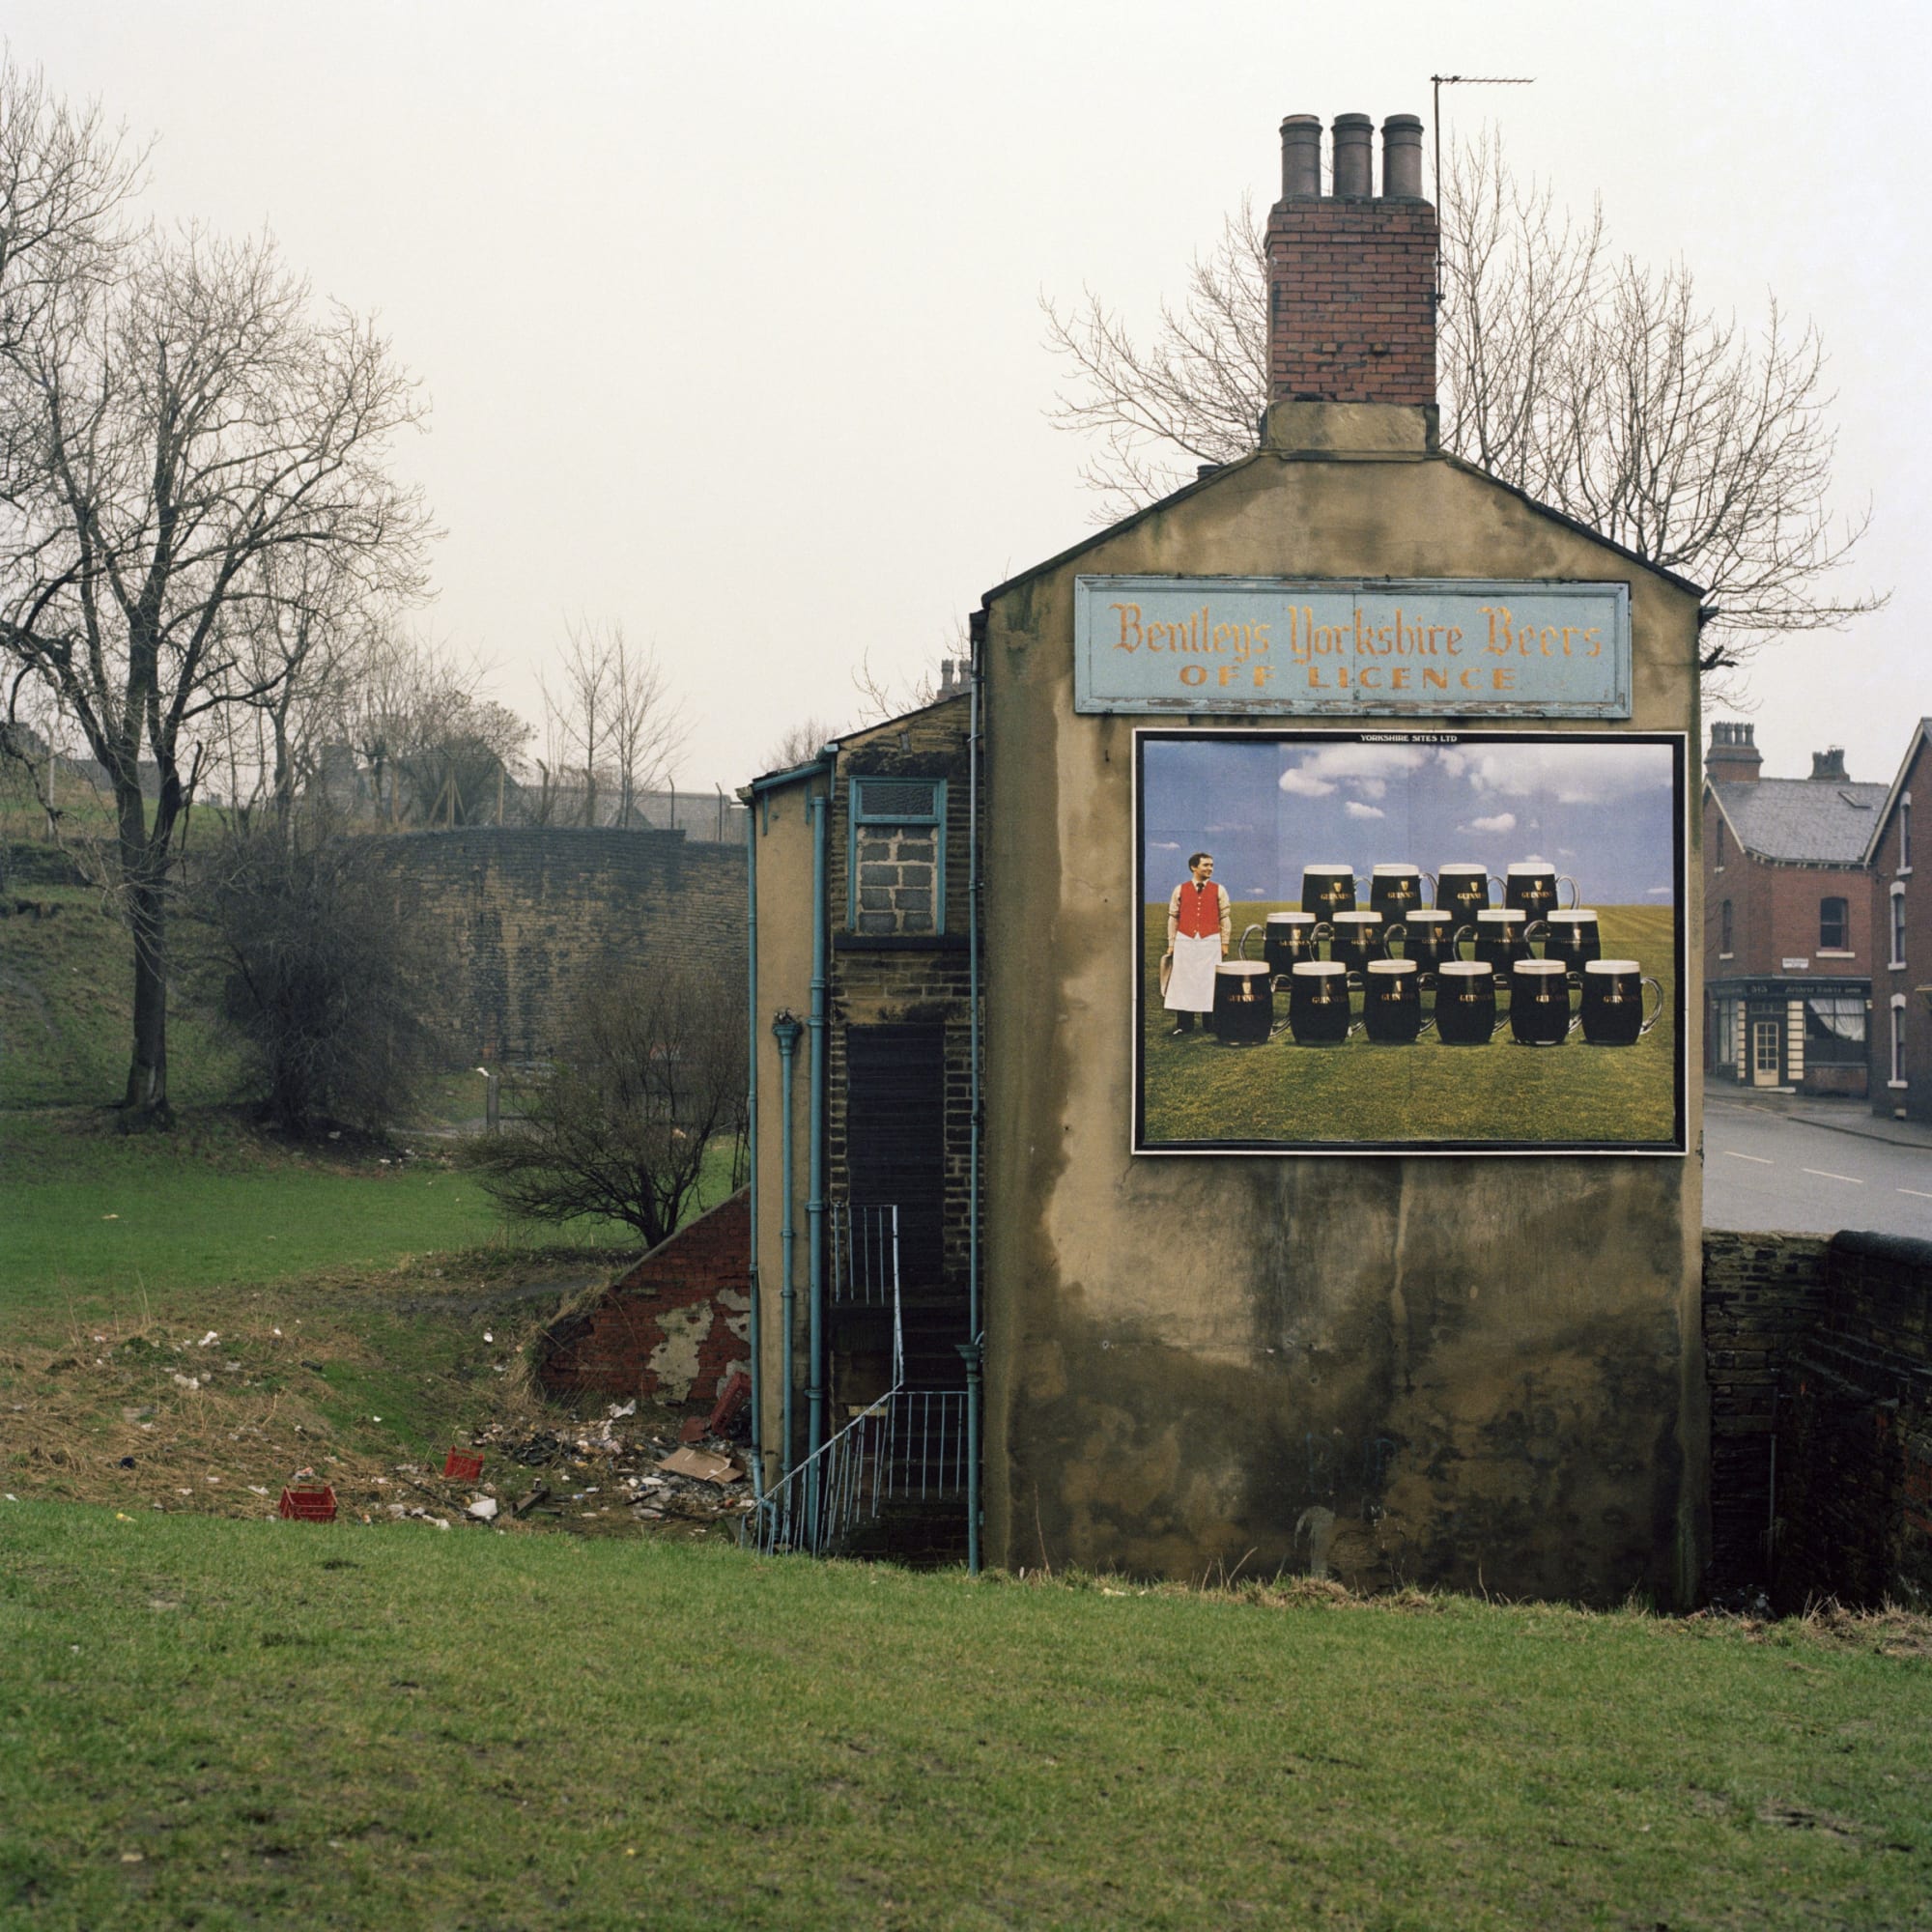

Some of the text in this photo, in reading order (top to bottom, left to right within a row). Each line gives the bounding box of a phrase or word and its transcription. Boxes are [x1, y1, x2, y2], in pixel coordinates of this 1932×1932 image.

[1109, 602, 1602, 665] Bentley's Yorkshire Beers
[1179, 665, 1517, 691] OFF LICENCE
[1411, 734, 1437, 743] SITES
[1387, 891, 1417, 899] GUINN
[1457, 892, 1487, 900] GUINN
